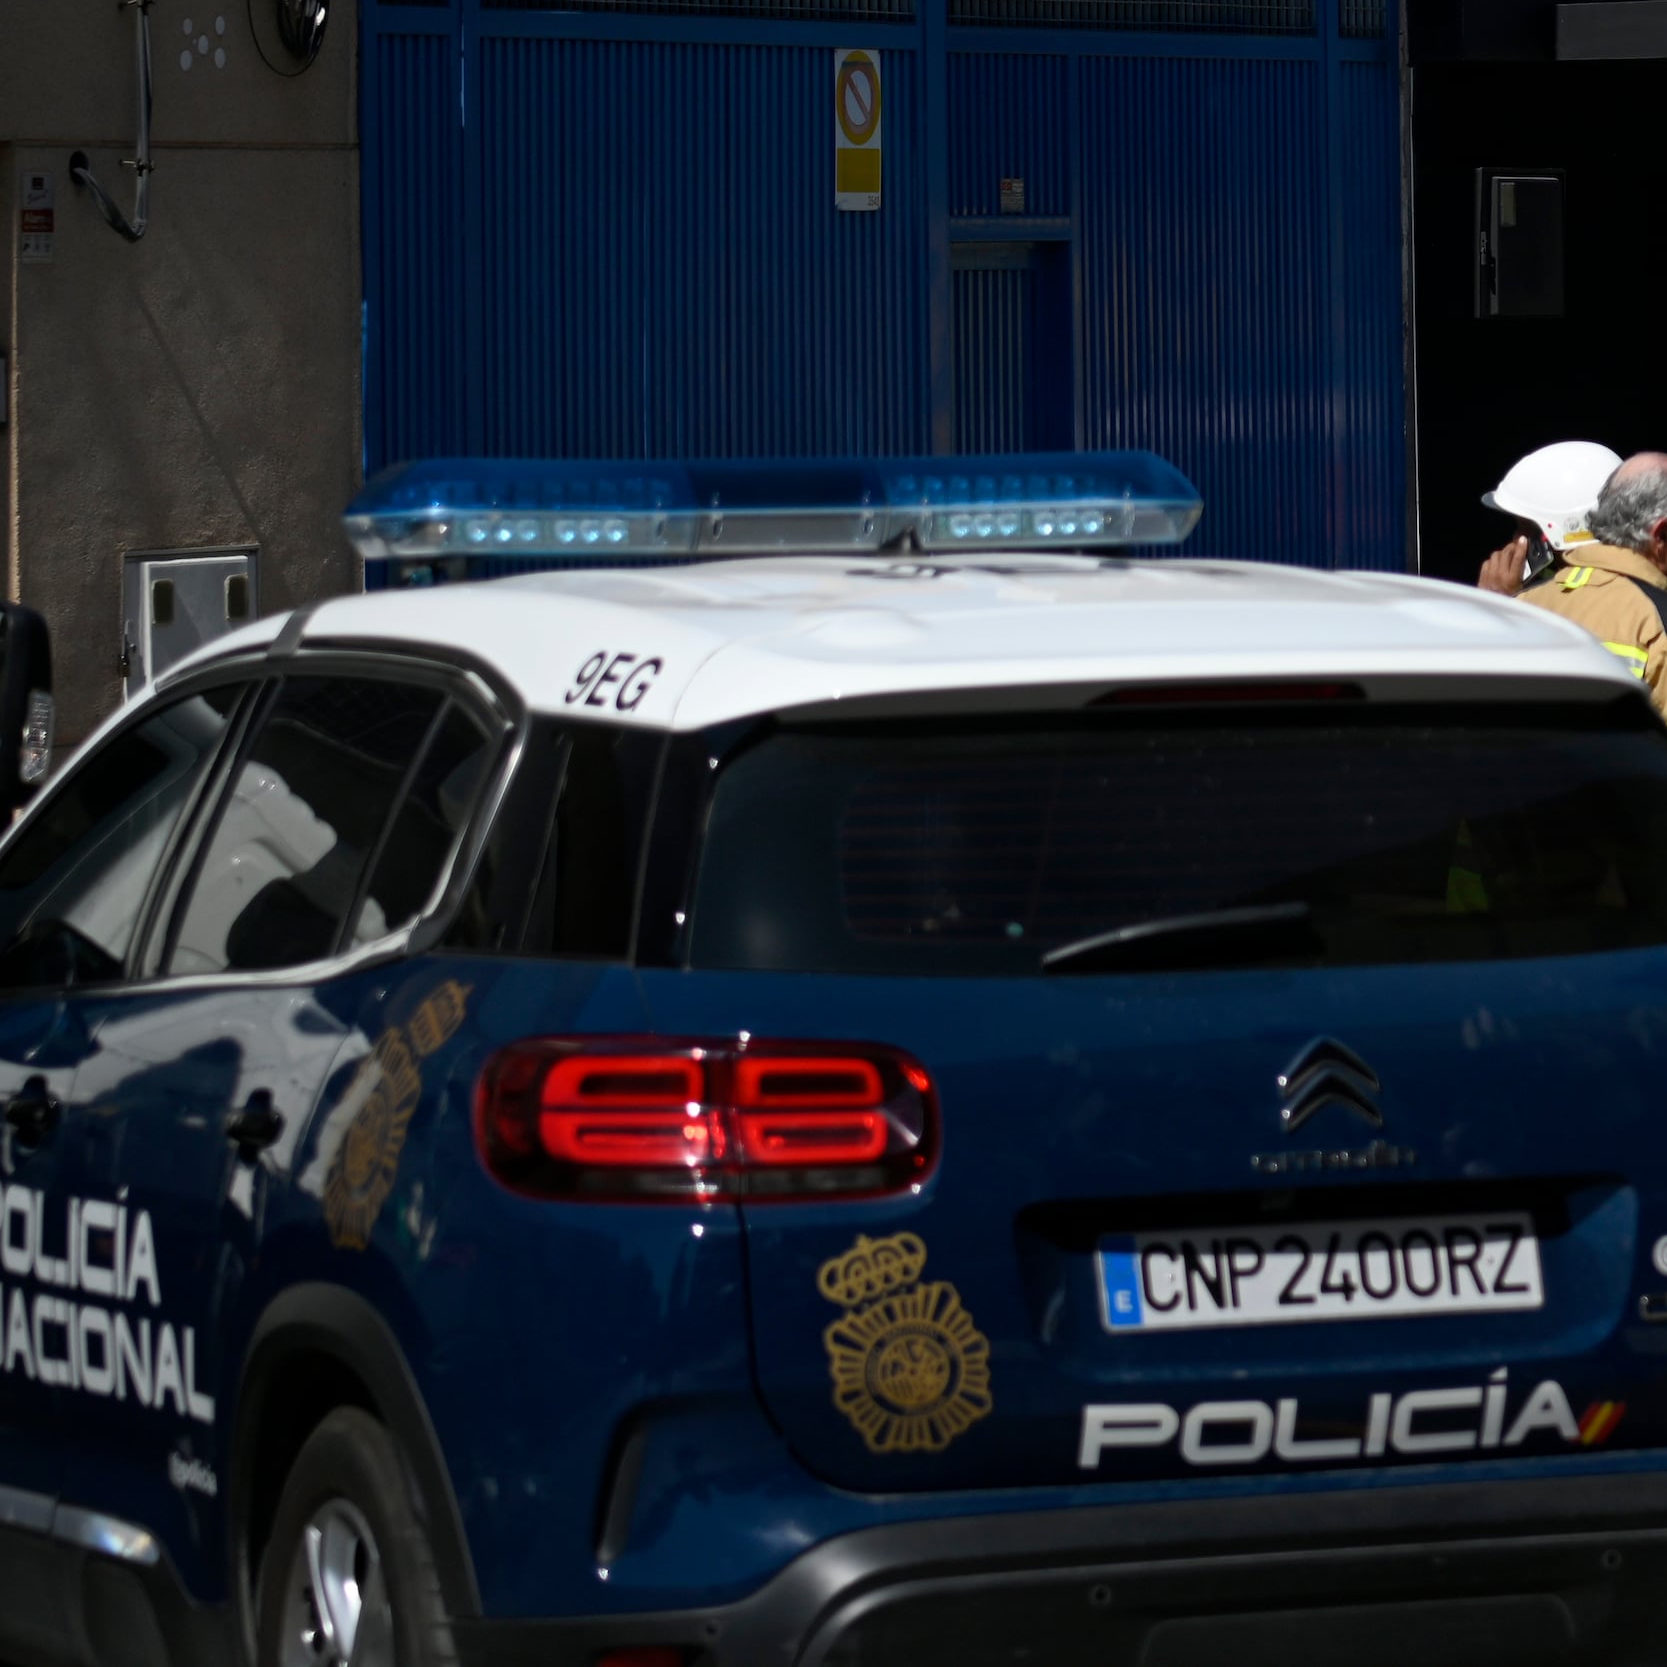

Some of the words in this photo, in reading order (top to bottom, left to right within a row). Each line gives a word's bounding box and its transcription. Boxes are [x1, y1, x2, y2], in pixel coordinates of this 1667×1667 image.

[565, 650, 664, 712] 9EG
[1115, 1289, 1132, 1313] E
[0, 1282, 216, 1426] ACIONAL
[1077, 1366, 1581, 1469] POLICÍA
